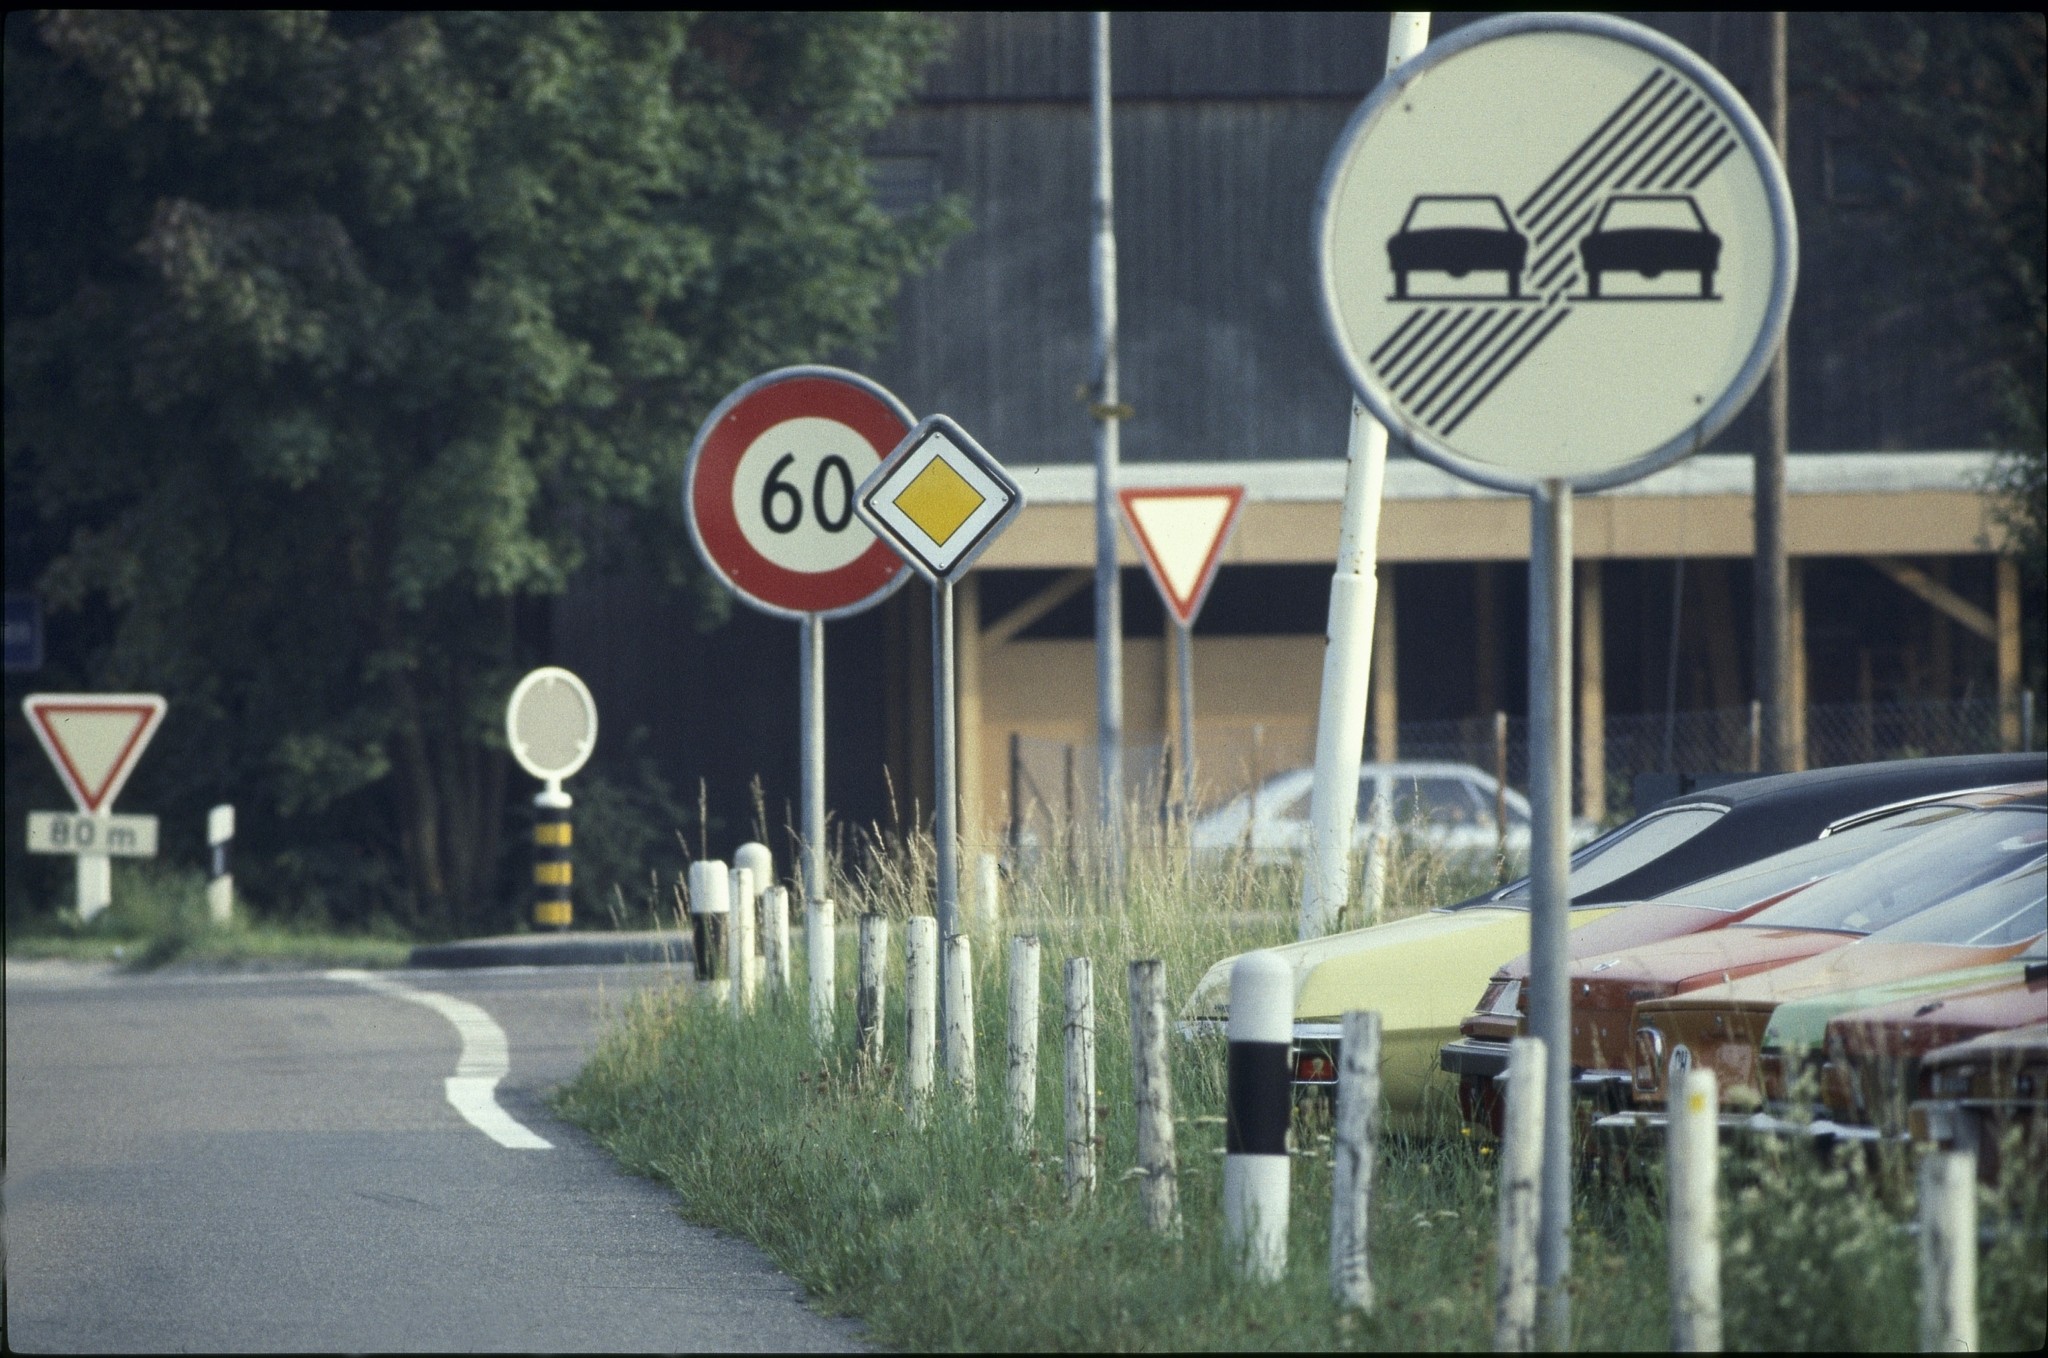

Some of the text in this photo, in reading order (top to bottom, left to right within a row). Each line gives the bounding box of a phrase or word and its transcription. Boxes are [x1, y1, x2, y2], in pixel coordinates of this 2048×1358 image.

[761, 453, 856, 533] 60
[51, 815, 138, 849] 80 m
